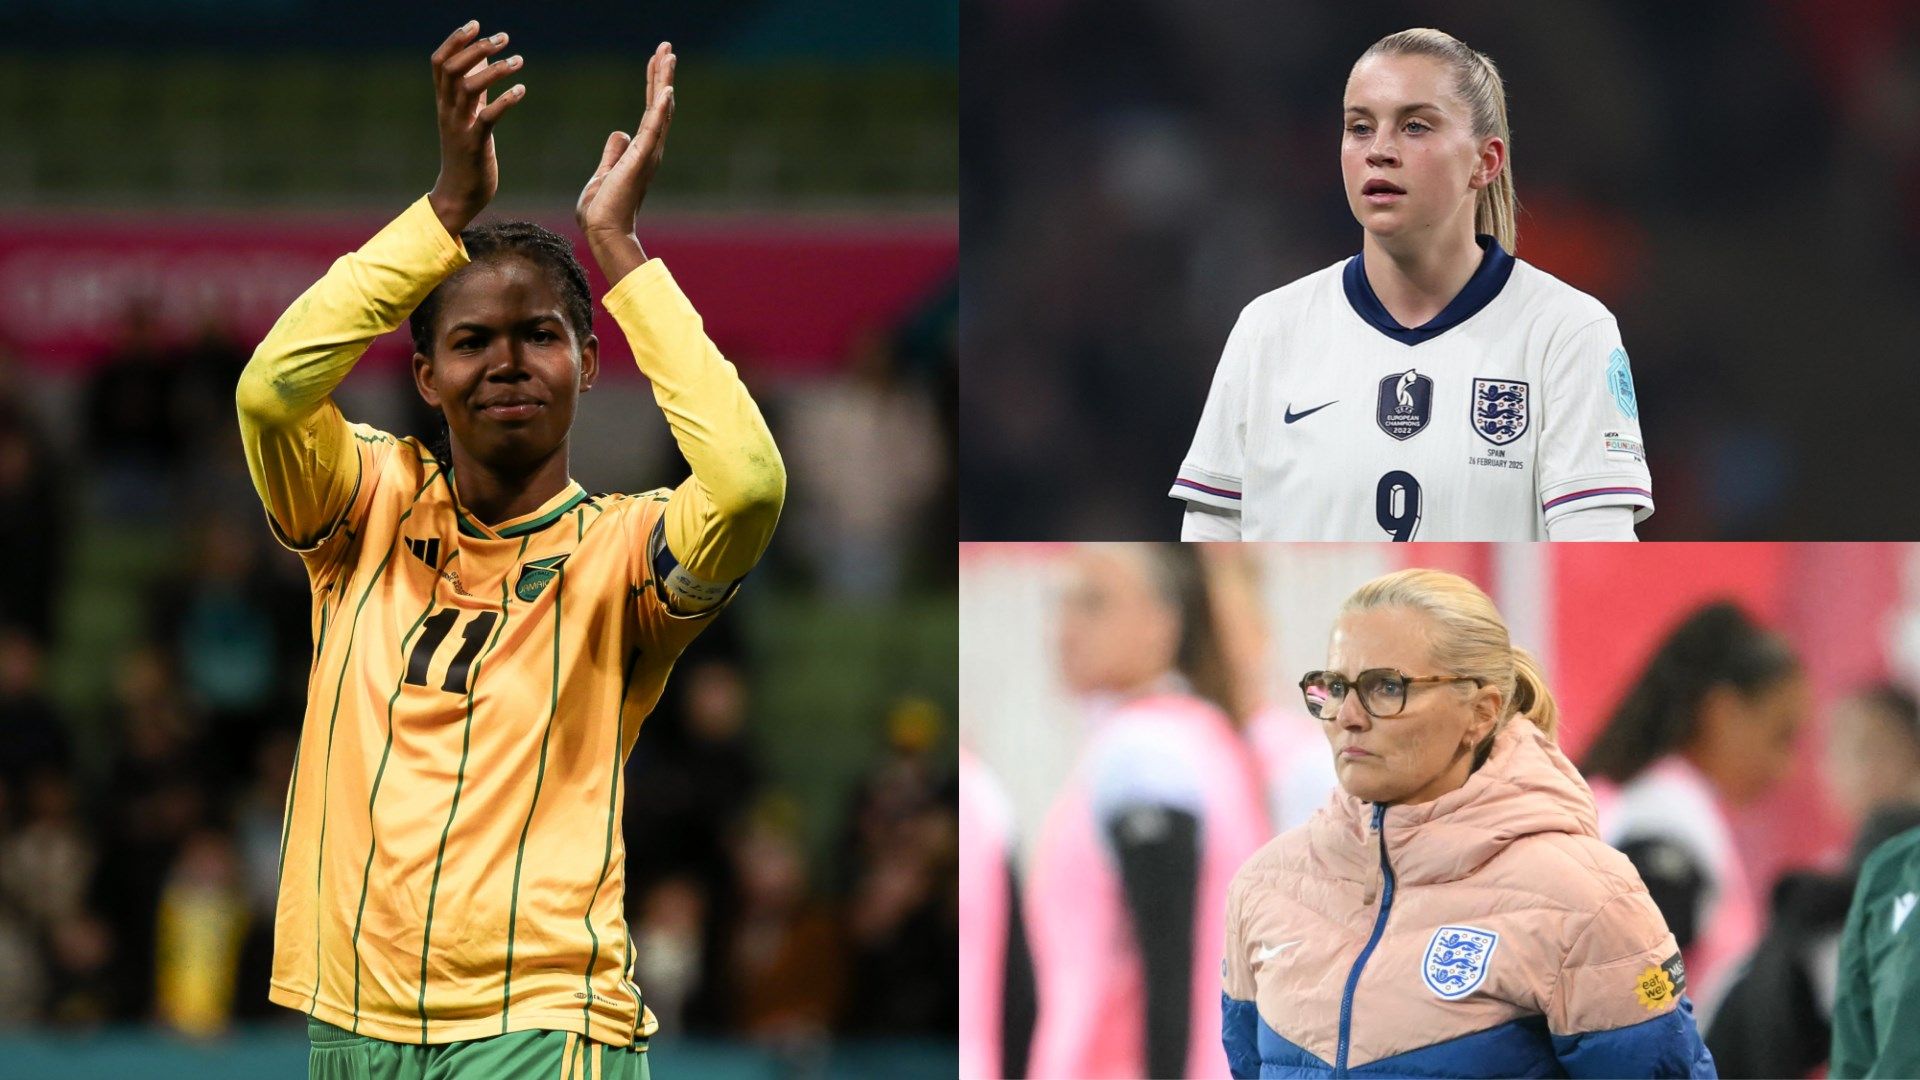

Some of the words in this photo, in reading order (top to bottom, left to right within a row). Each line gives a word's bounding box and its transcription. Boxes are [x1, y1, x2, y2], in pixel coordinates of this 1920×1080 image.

[1487, 448, 1506, 458] SPAIN
[1468, 456, 1476, 465] 26
[1476, 457, 1508, 468] FEBRUARY
[1508, 460, 1524, 470] 2025
[1376, 470, 1422, 542] 9
[404, 607, 499, 695] 11
[1642, 973, 1661, 990] eat
[1645, 979, 1668, 998] well
